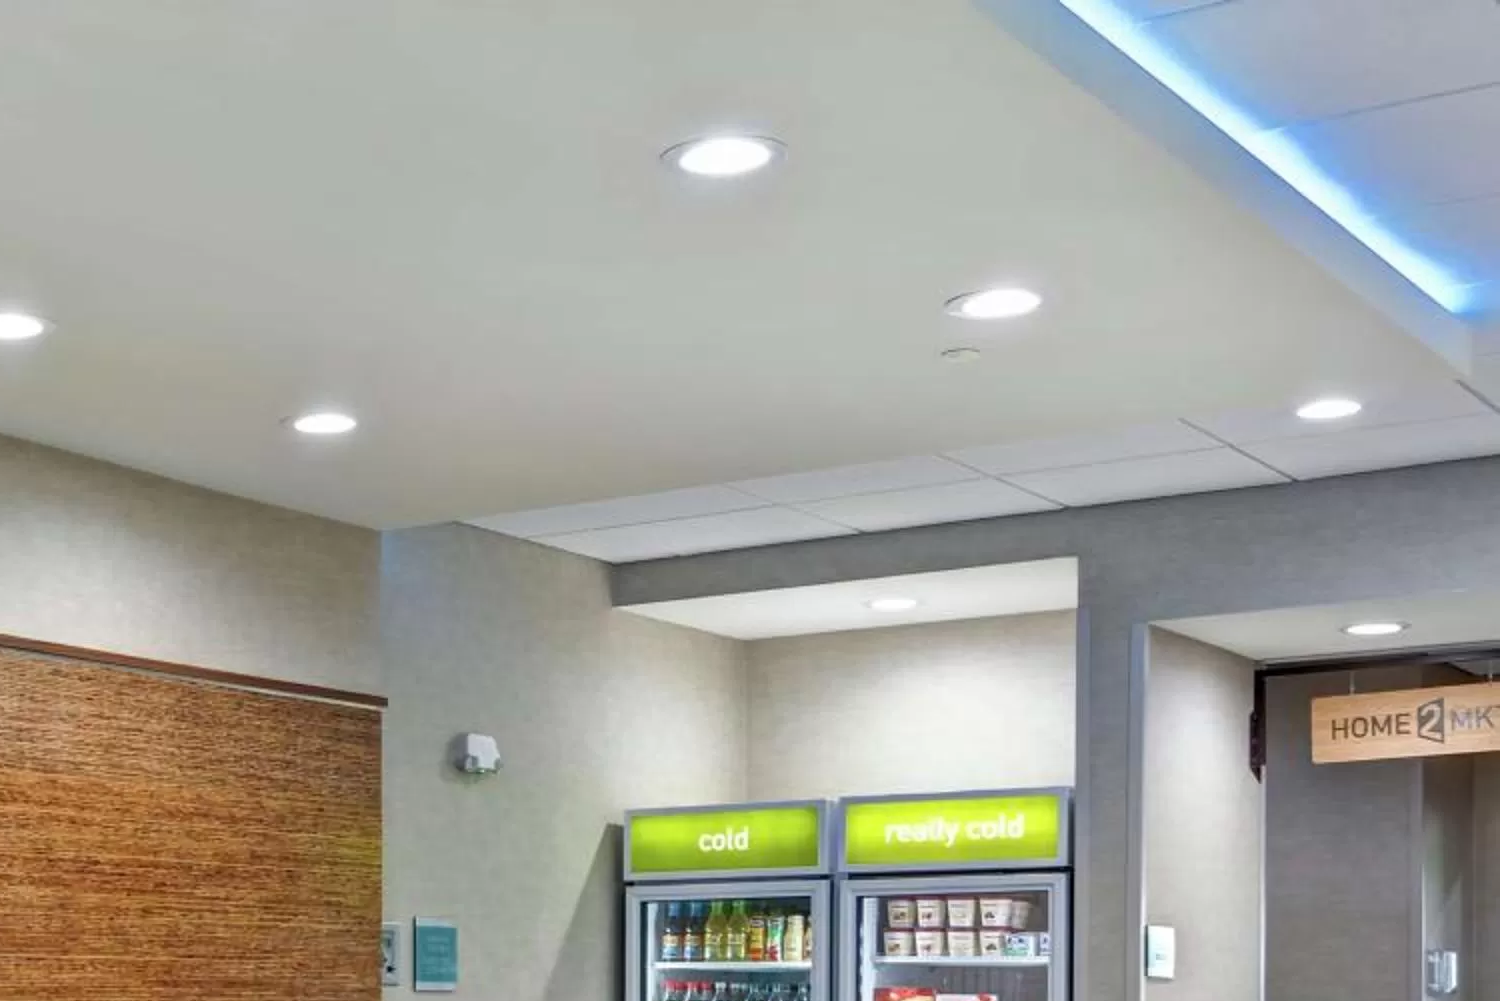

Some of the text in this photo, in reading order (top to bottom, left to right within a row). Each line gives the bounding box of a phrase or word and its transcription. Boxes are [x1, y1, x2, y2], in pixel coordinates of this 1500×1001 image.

[1331, 713, 1411, 741] HOME
[698, 825, 749, 851] cold
[884, 812, 1025, 848] really cold
